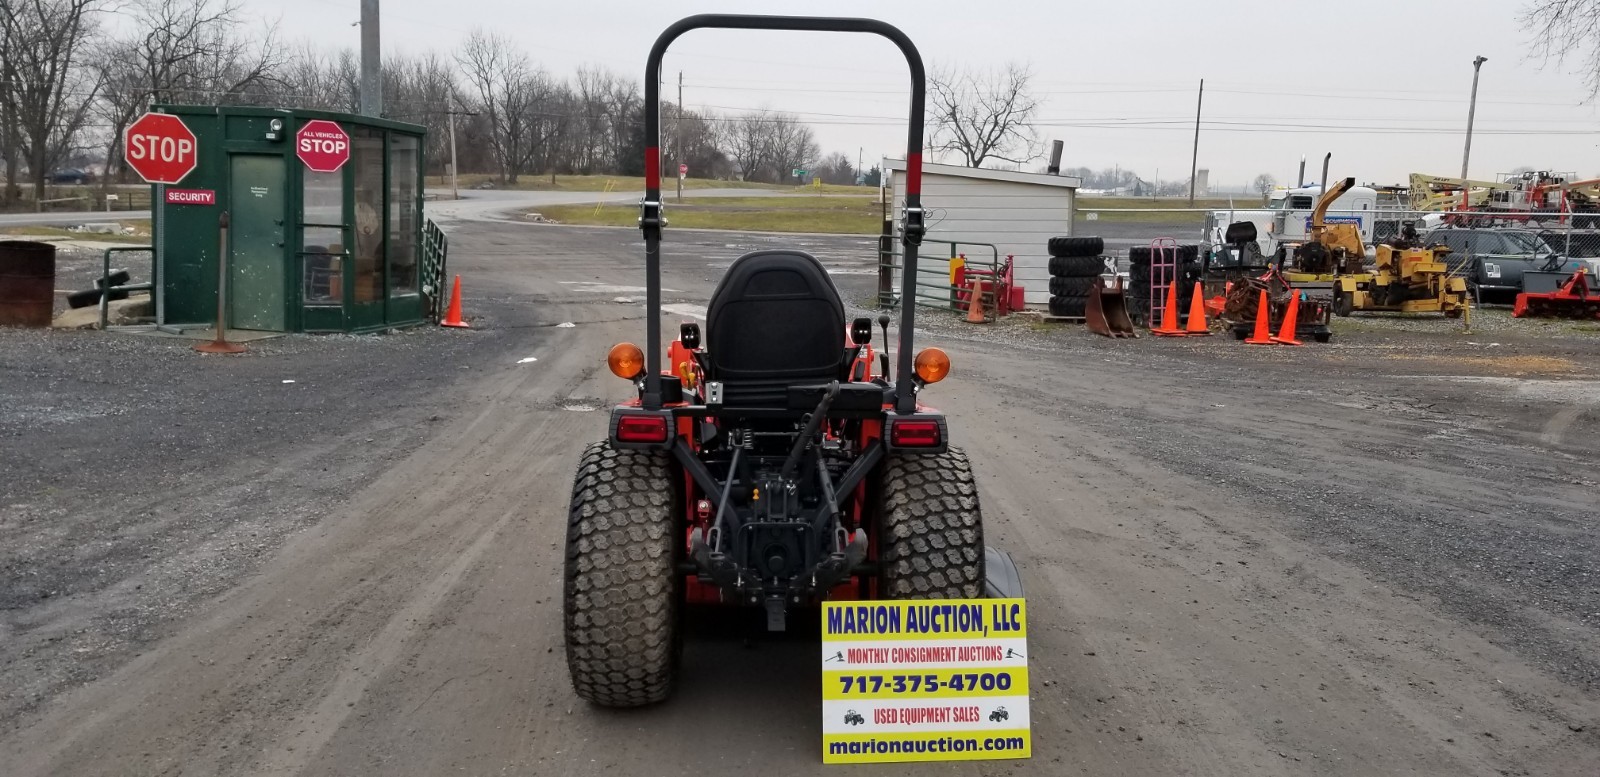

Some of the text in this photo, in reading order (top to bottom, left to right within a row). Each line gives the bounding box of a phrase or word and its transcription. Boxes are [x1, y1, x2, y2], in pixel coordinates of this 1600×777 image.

[315, 131, 343, 139] VEHICLES
[130, 133, 192, 163] STOP
[300, 138, 346, 154] STOP
[168, 192, 212, 202] SECURITY
[827, 603, 1021, 638] MARION AUCTION, LLC
[847, 645, 1003, 664] MONTHLY CONSIGNMENT AUCTIONS
[839, 672, 1012, 694] 717-375-4700
[873, 706, 980, 726] USED EQUIPMENT SALES
[829, 736, 1024, 755] marionauction.com
